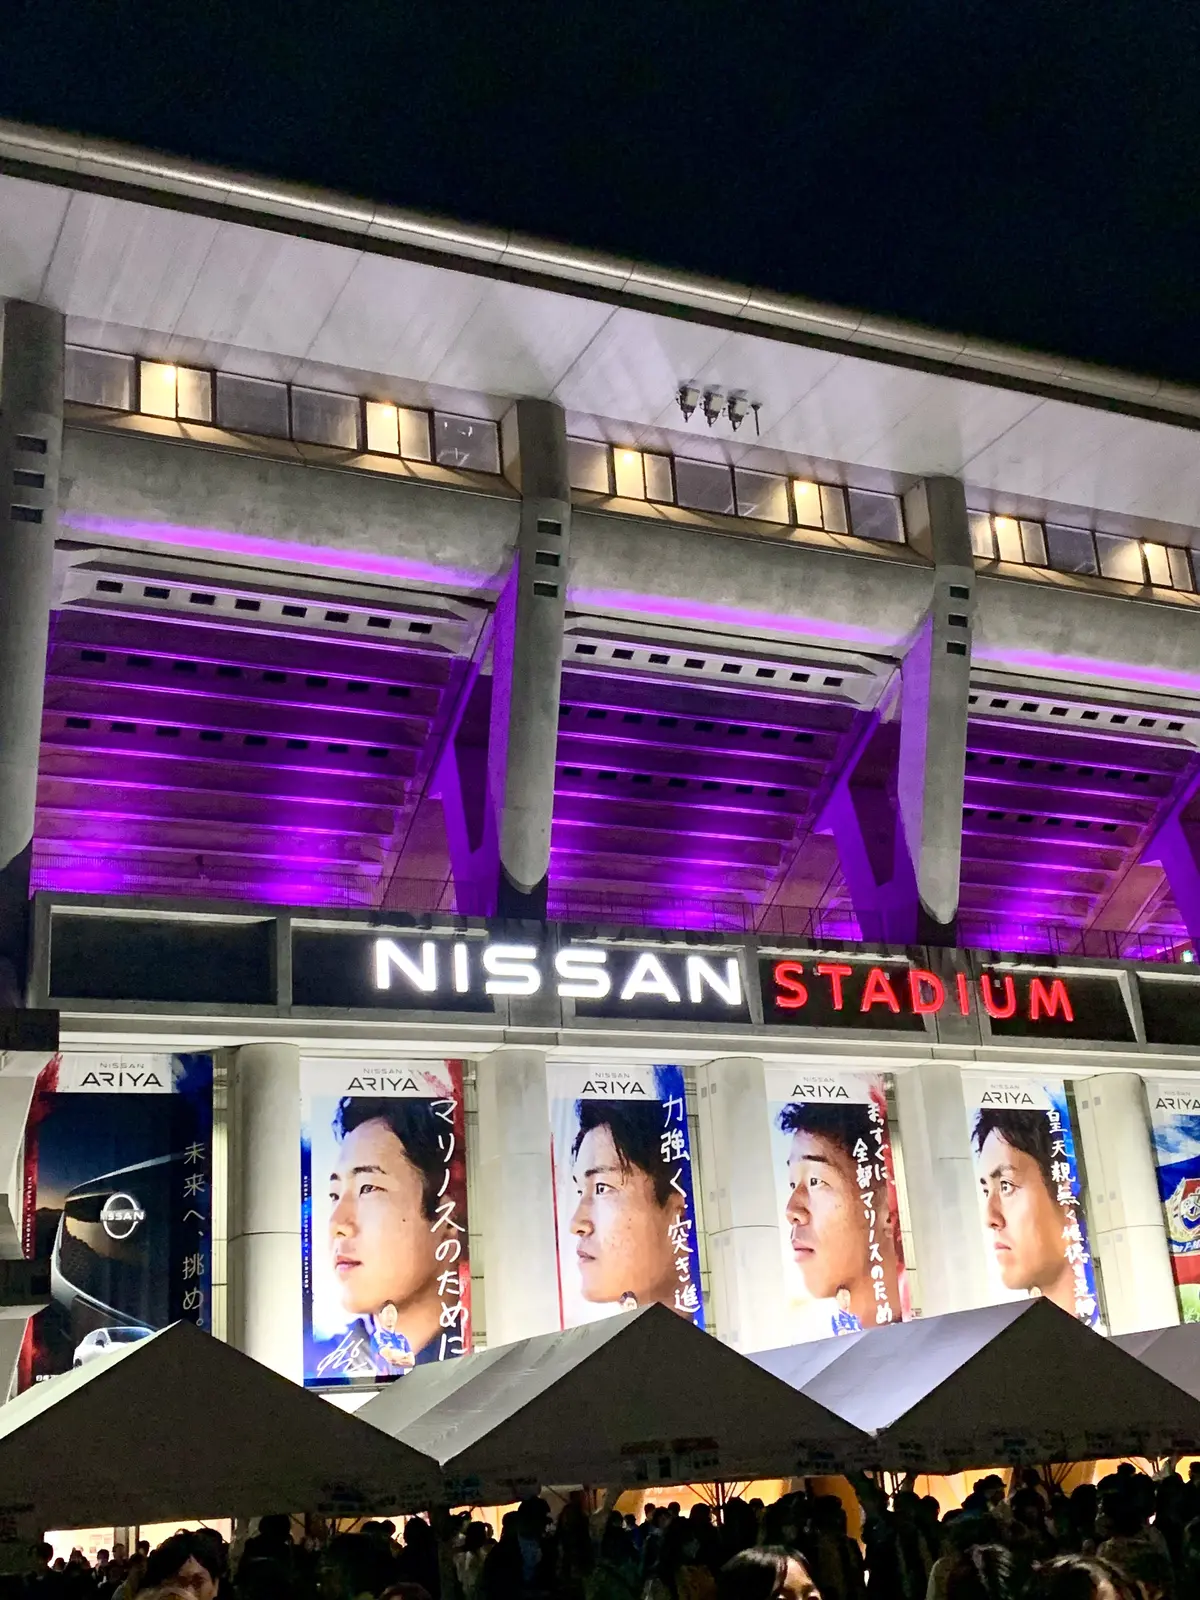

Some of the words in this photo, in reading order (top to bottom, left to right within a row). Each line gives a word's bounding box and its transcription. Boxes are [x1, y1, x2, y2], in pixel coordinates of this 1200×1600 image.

[375, 938, 742, 1005] NISSAN
[774, 961, 1074, 1021] STADIUM
[79, 1072, 163, 1087] ARIYA
[347, 1078, 420, 1092] ARIYA
[581, 1081, 646, 1095] ARIYA
[791, 1084, 850, 1099] ARIYA
[980, 1091, 1035, 1105] ARIYA
[660, 1094, 701, 1325] 力強く、突き進
[182, 1141, 205, 1327] 未来へ、挑め。
[429, 1099, 468, 1361] マリノスのために
